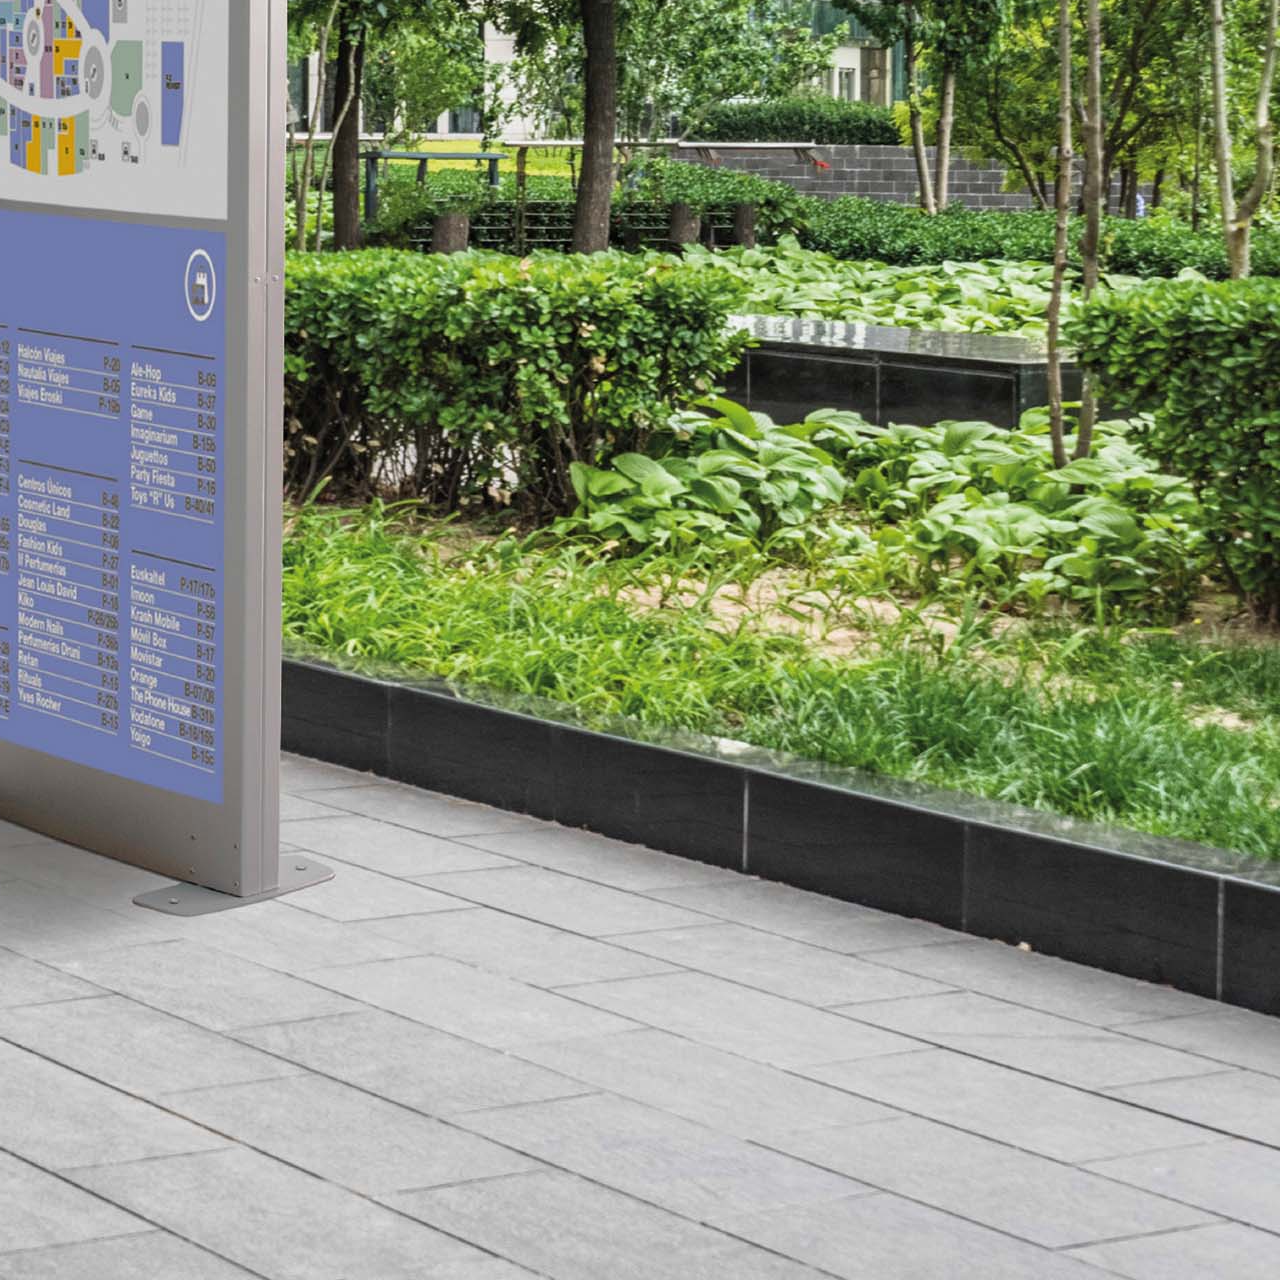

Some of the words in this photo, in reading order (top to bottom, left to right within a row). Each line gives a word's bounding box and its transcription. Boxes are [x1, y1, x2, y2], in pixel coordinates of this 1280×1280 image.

[44, 348, 65, 366] Viajes
[18, 364, 47, 381] Nautalia
[48, 368, 69, 387] Viajes
[130, 362, 162, 383] Ale-Hop
[18, 384, 39, 402] Viajes
[40, 387, 63, 404] Eroski
[130, 382, 157, 400] Eureka
[159, 386, 177, 404] Kids
[130, 404, 153, 421] Game
[130, 424, 178, 446] Imaginarium
[130, 446, 168, 466] Juguettos
[18, 474, 45, 493] Centros
[130, 464, 150, 485] Party
[152, 469, 176, 488] Fiesta
[18, 494, 51, 514] Cosmetic
[52, 502, 70, 519] Land
[130, 486, 148, 505] Toys
[164, 493, 175, 509] Us
[18, 514, 47, 533] Douglas
[18, 534, 45, 552] Fashion
[47, 540, 63, 556] Kids
[130, 564, 166, 586] Euskaltel
[18, 574, 35, 588] Jean
[36, 577, 55, 594] Louis
[56, 582, 77, 600] David
[18, 592, 34, 608] Kiko
[18, 611, 45, 630] Modern
[46, 618, 64, 636] Nails
[154, 614, 180, 632] Mobile
[152, 632, 167, 649] Box
[130, 646, 164, 668] Movistar
[18, 669, 42, 688] Rituals
[130, 668, 158, 689] Orange
[18, 688, 34, 705] Yves
[36, 692, 62, 712] Rocher
[130, 686, 144, 704] The
[144, 690, 167, 711] Phone
[168, 699, 191, 717] House
[130, 708, 166, 730] Vodafone
[130, 726, 152, 747] Yoigo
